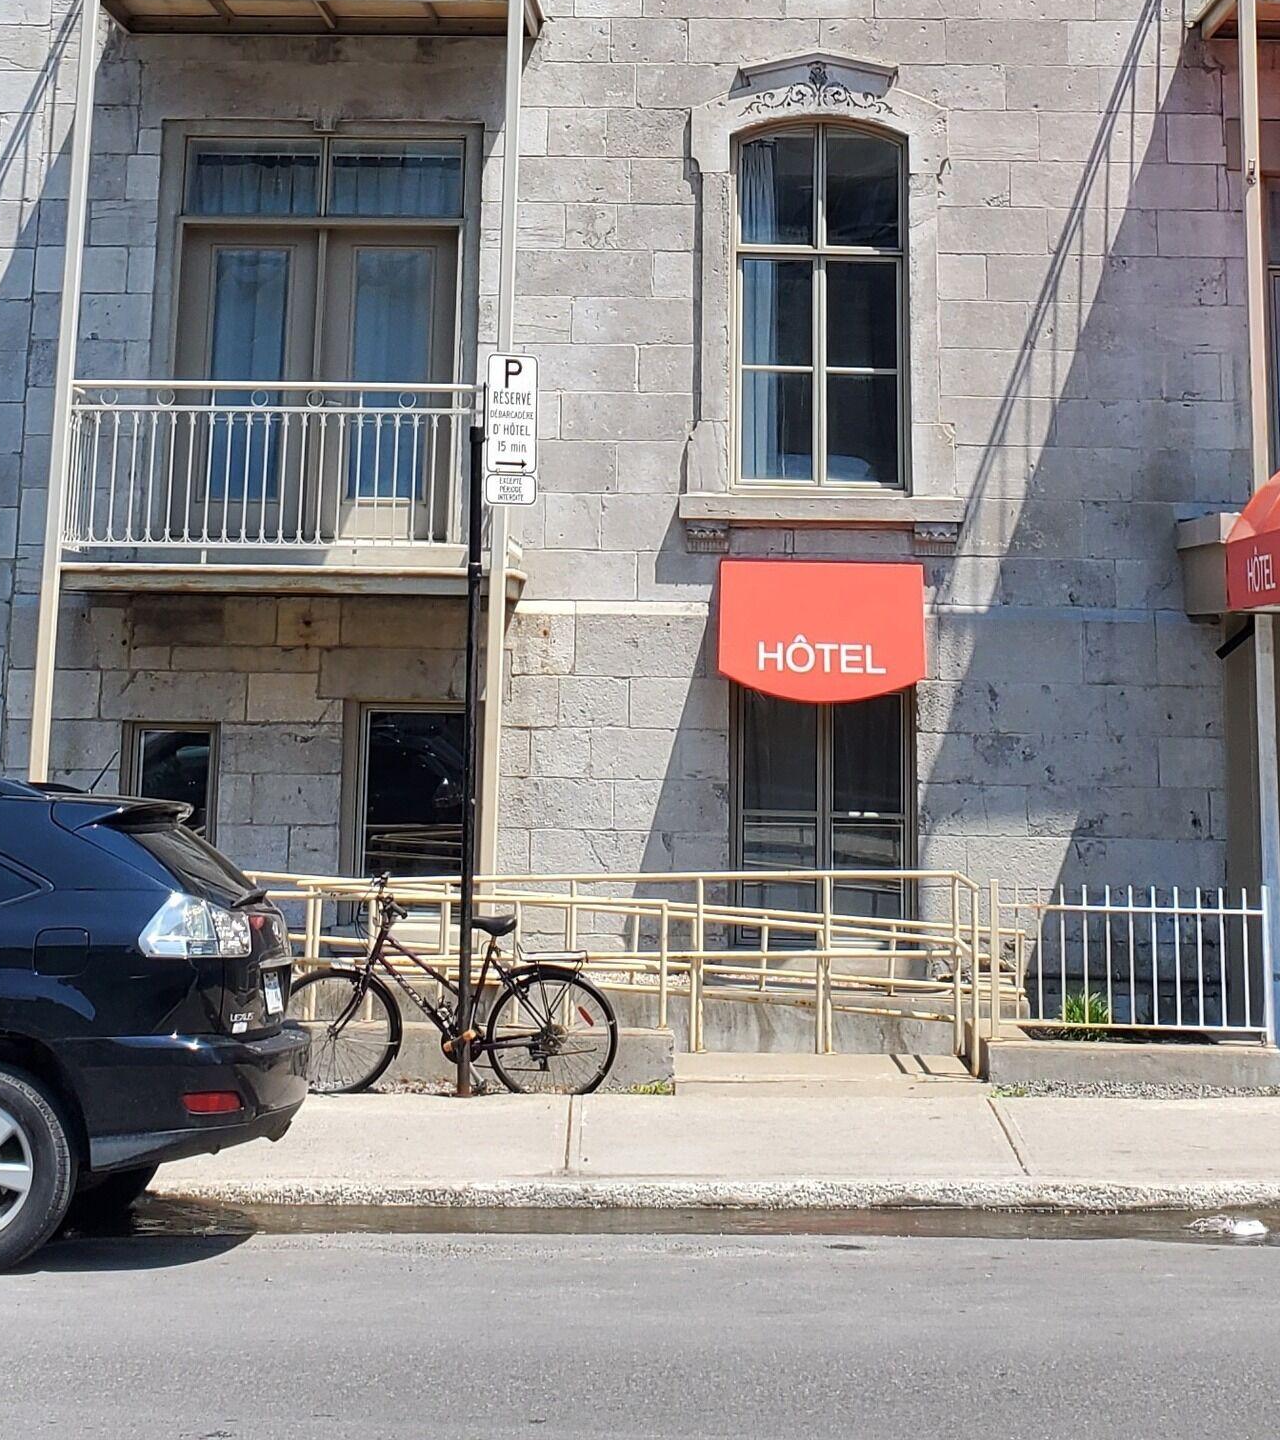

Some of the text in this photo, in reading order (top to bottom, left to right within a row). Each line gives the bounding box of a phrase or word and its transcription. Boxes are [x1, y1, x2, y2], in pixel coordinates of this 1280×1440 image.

[505, 359, 522, 388] P
[493, 391, 532, 405] RÉSERVÉ
[503, 422, 530, 436] HÔTEL
[498, 441, 527, 453] 15 min
[1247, 546, 1276, 592] HÔTEL
[758, 633, 887, 675] HÔTEL
[230, 1012, 255, 1022] LEXUS
